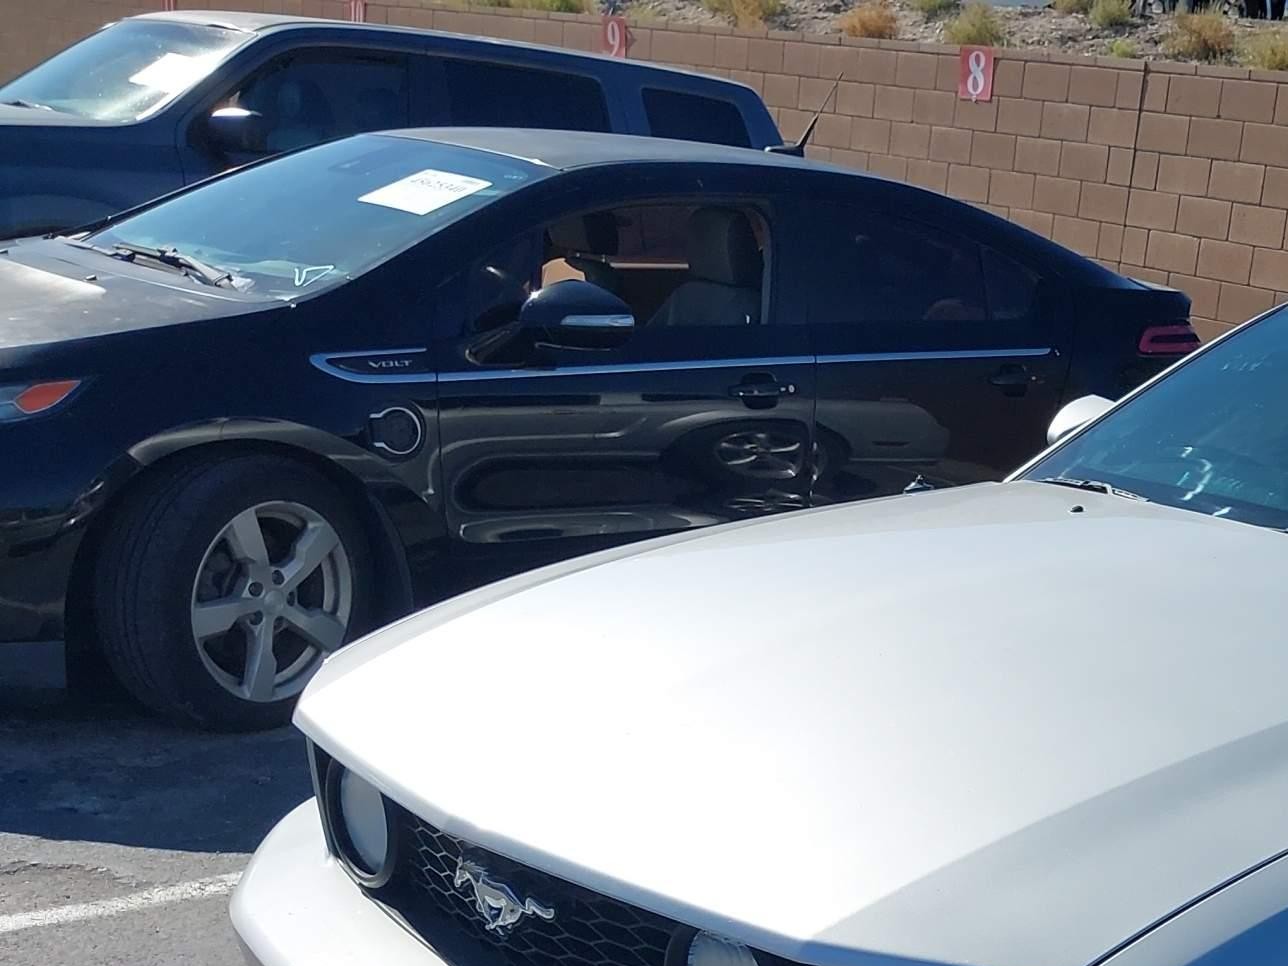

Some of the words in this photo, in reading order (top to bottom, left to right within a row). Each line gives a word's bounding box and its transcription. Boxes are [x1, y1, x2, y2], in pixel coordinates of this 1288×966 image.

[607, 20, 620, 57] 9
[967, 50, 985, 95] 8
[368, 359, 412, 368] VOLT
